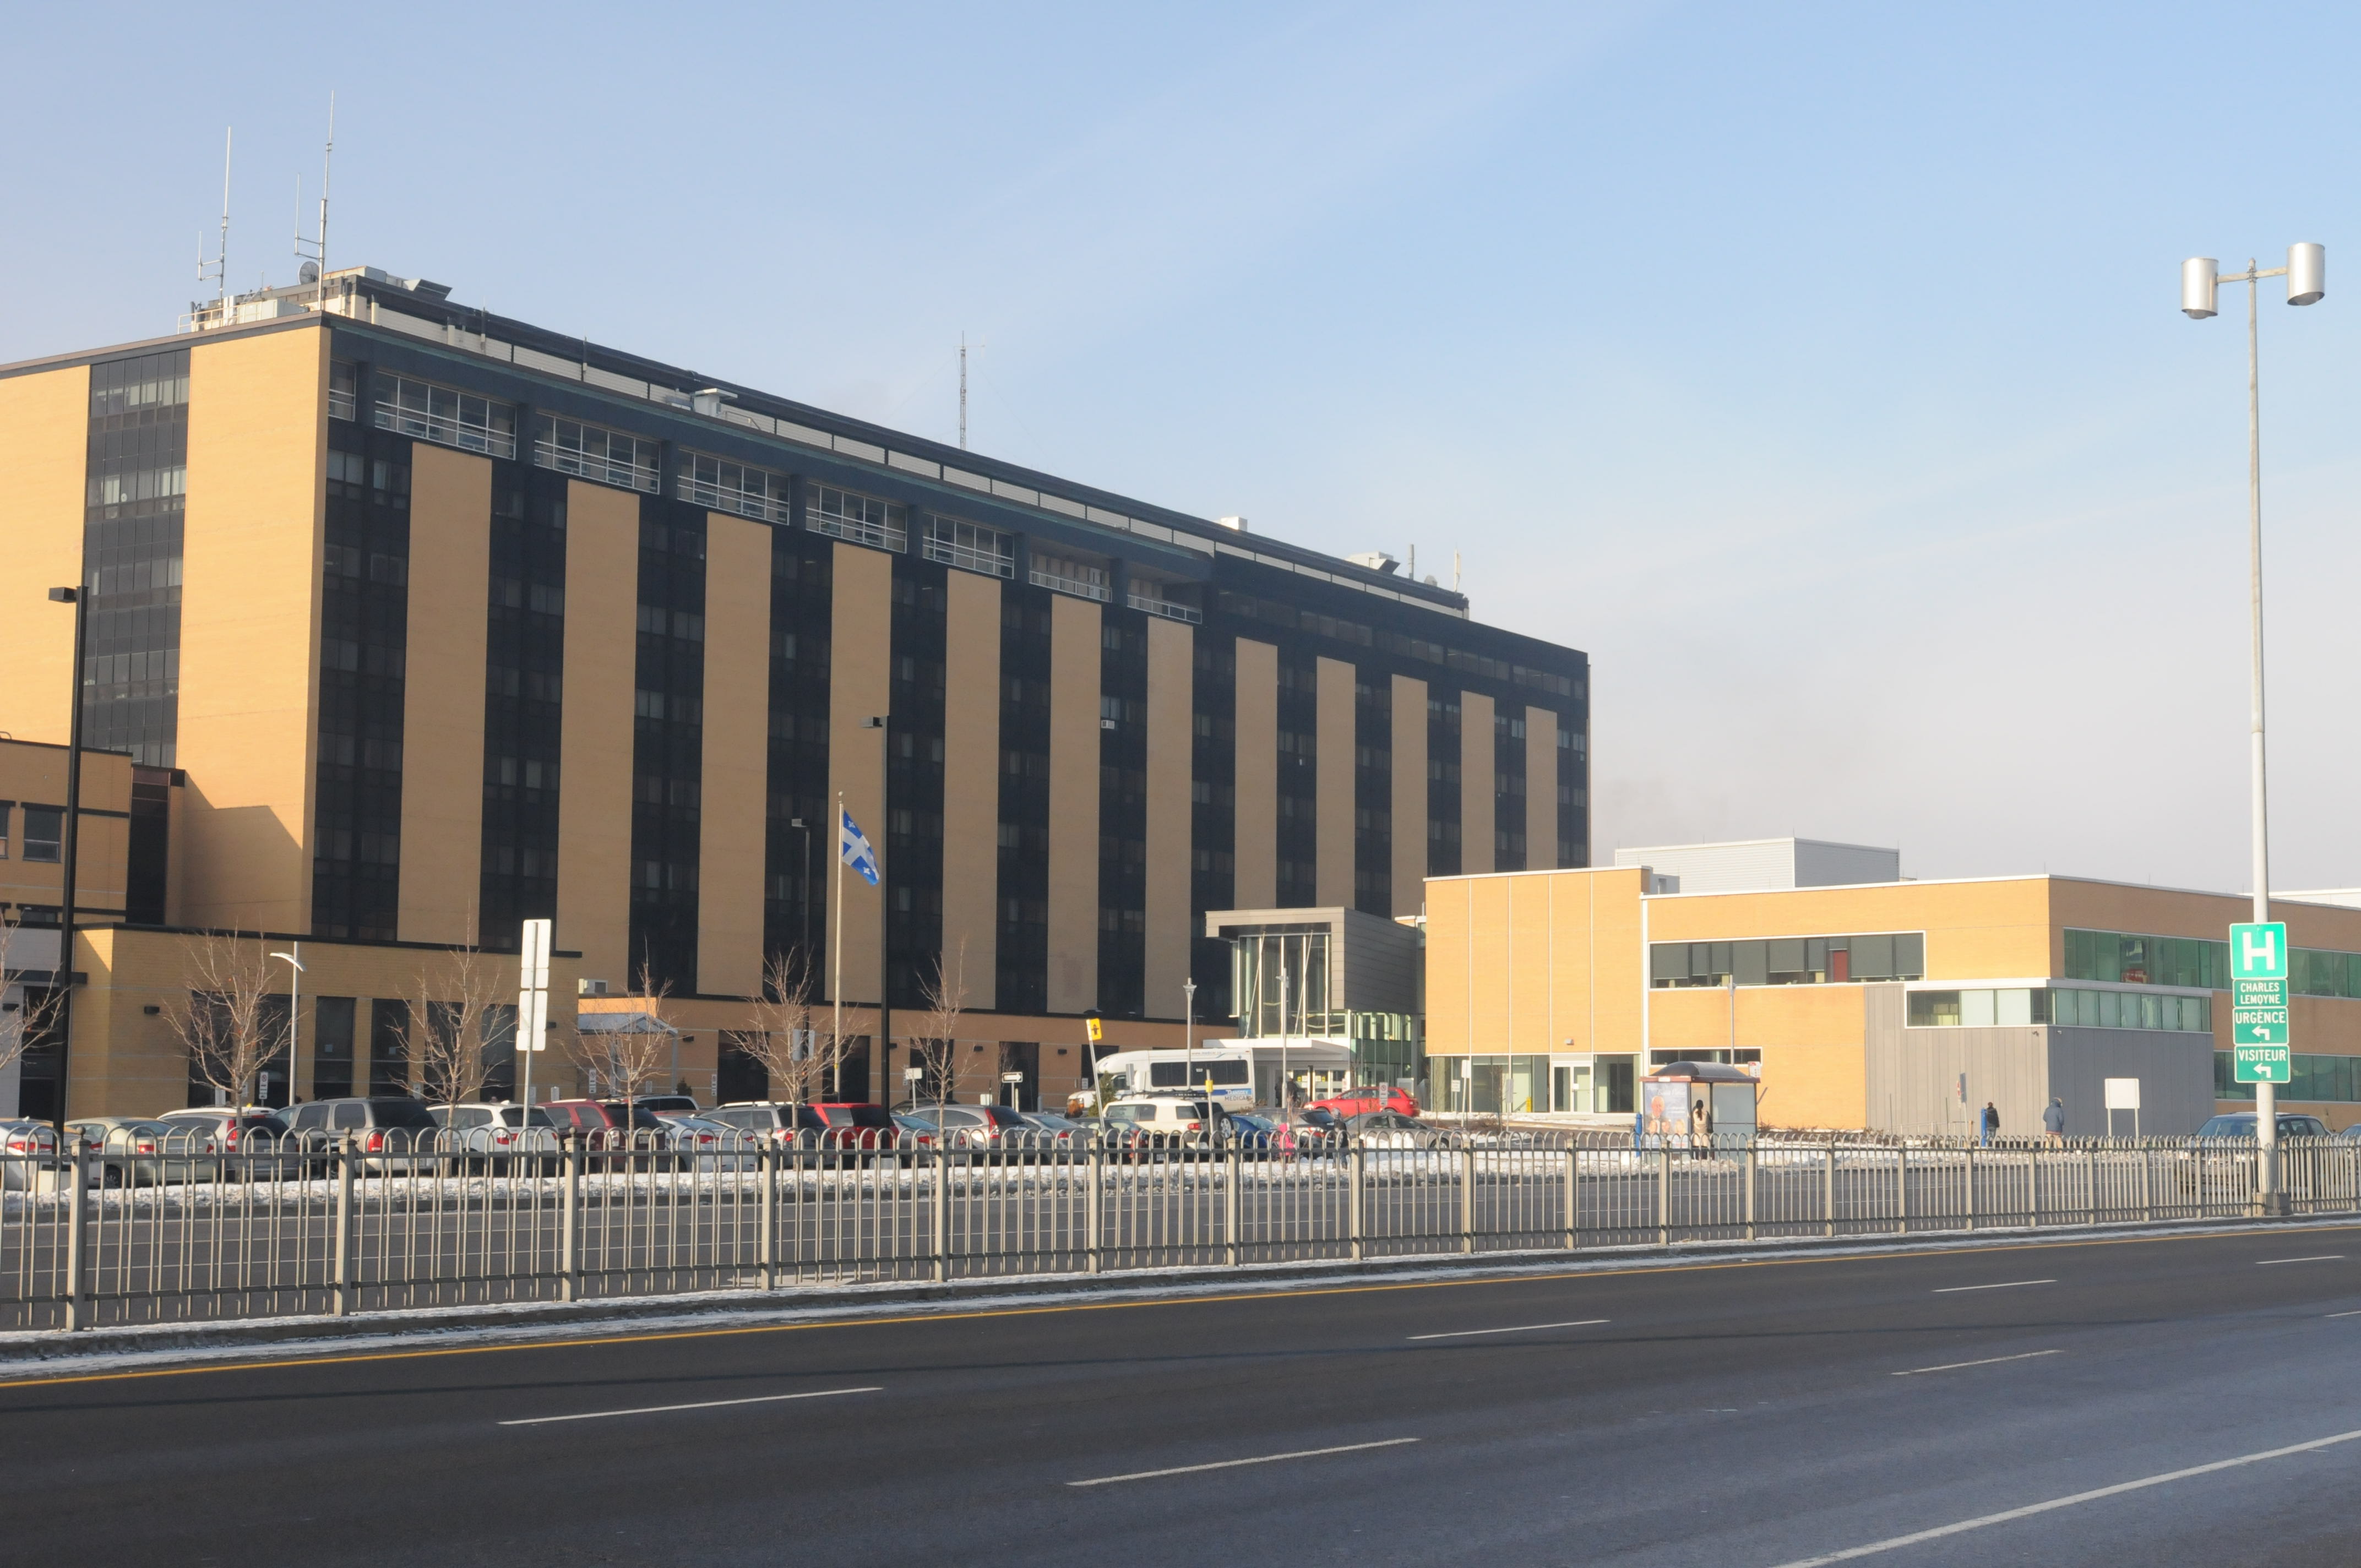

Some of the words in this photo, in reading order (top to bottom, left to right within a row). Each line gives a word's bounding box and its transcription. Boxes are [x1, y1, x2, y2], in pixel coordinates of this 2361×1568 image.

[2243, 931, 2275, 971] H
[2240, 982, 2280, 993] CHARLES
[2240, 994, 2280, 1005] LEMOYNE
[2235, 1011, 2286, 1023] URGENCE
[2238, 1049, 2286, 1061] VISITEUR
